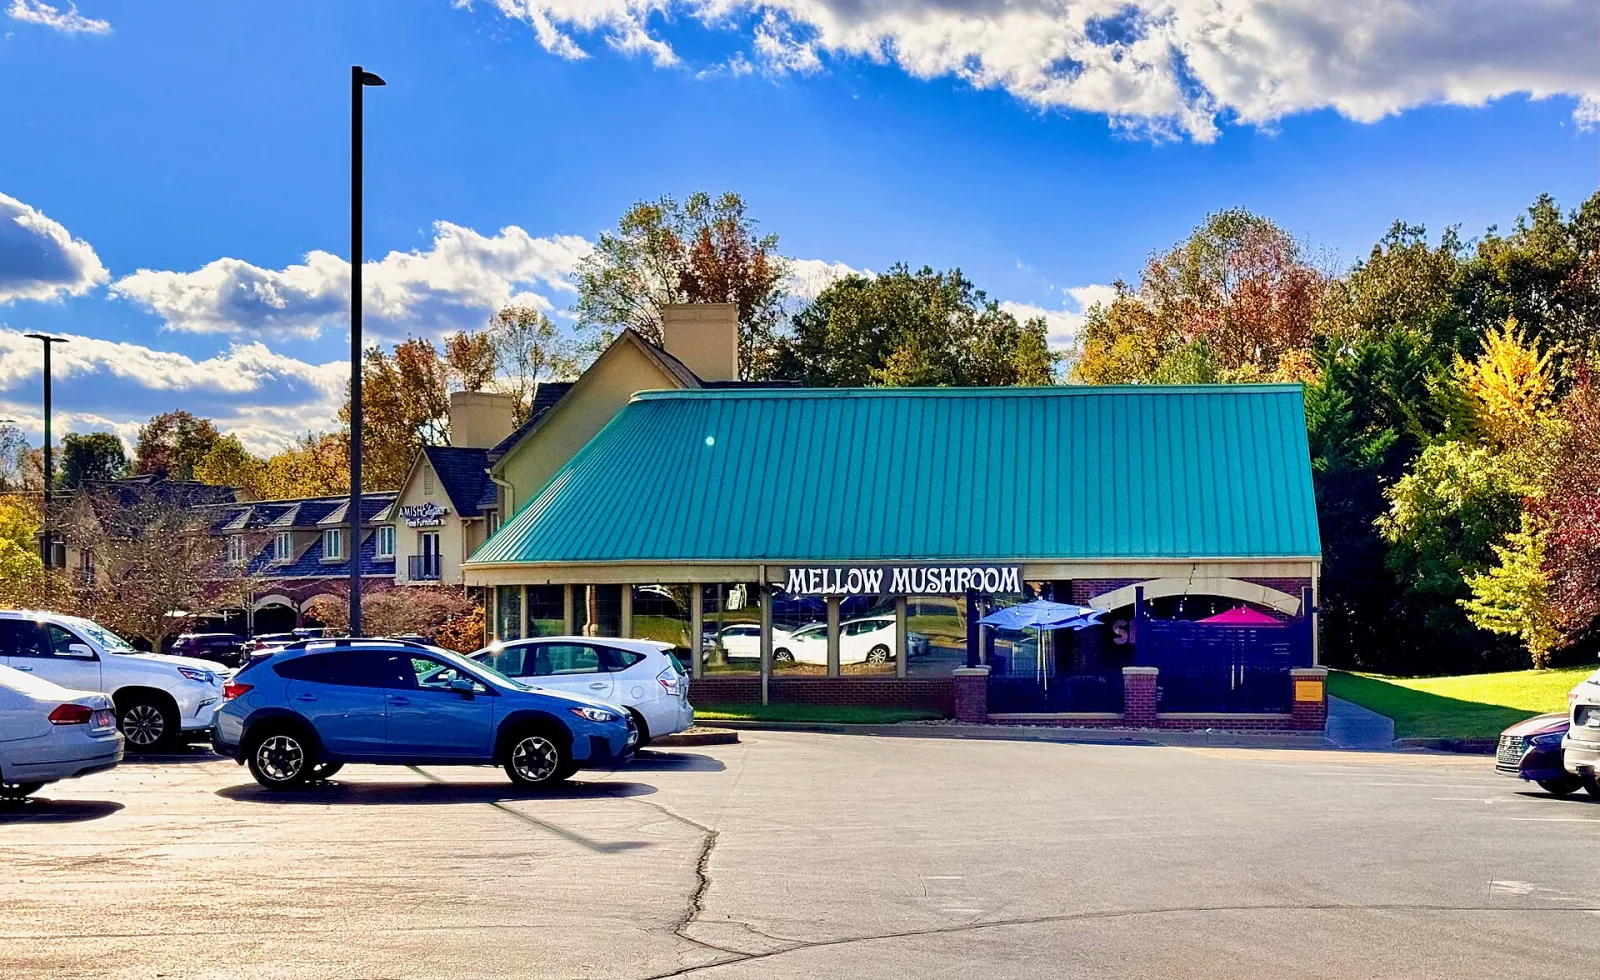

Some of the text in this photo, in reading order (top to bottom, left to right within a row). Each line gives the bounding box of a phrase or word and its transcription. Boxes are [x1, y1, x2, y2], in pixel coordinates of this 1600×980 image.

[398, 505, 422, 518] AMISH
[785, 567, 1021, 594] MELLOW MUSHROOM
